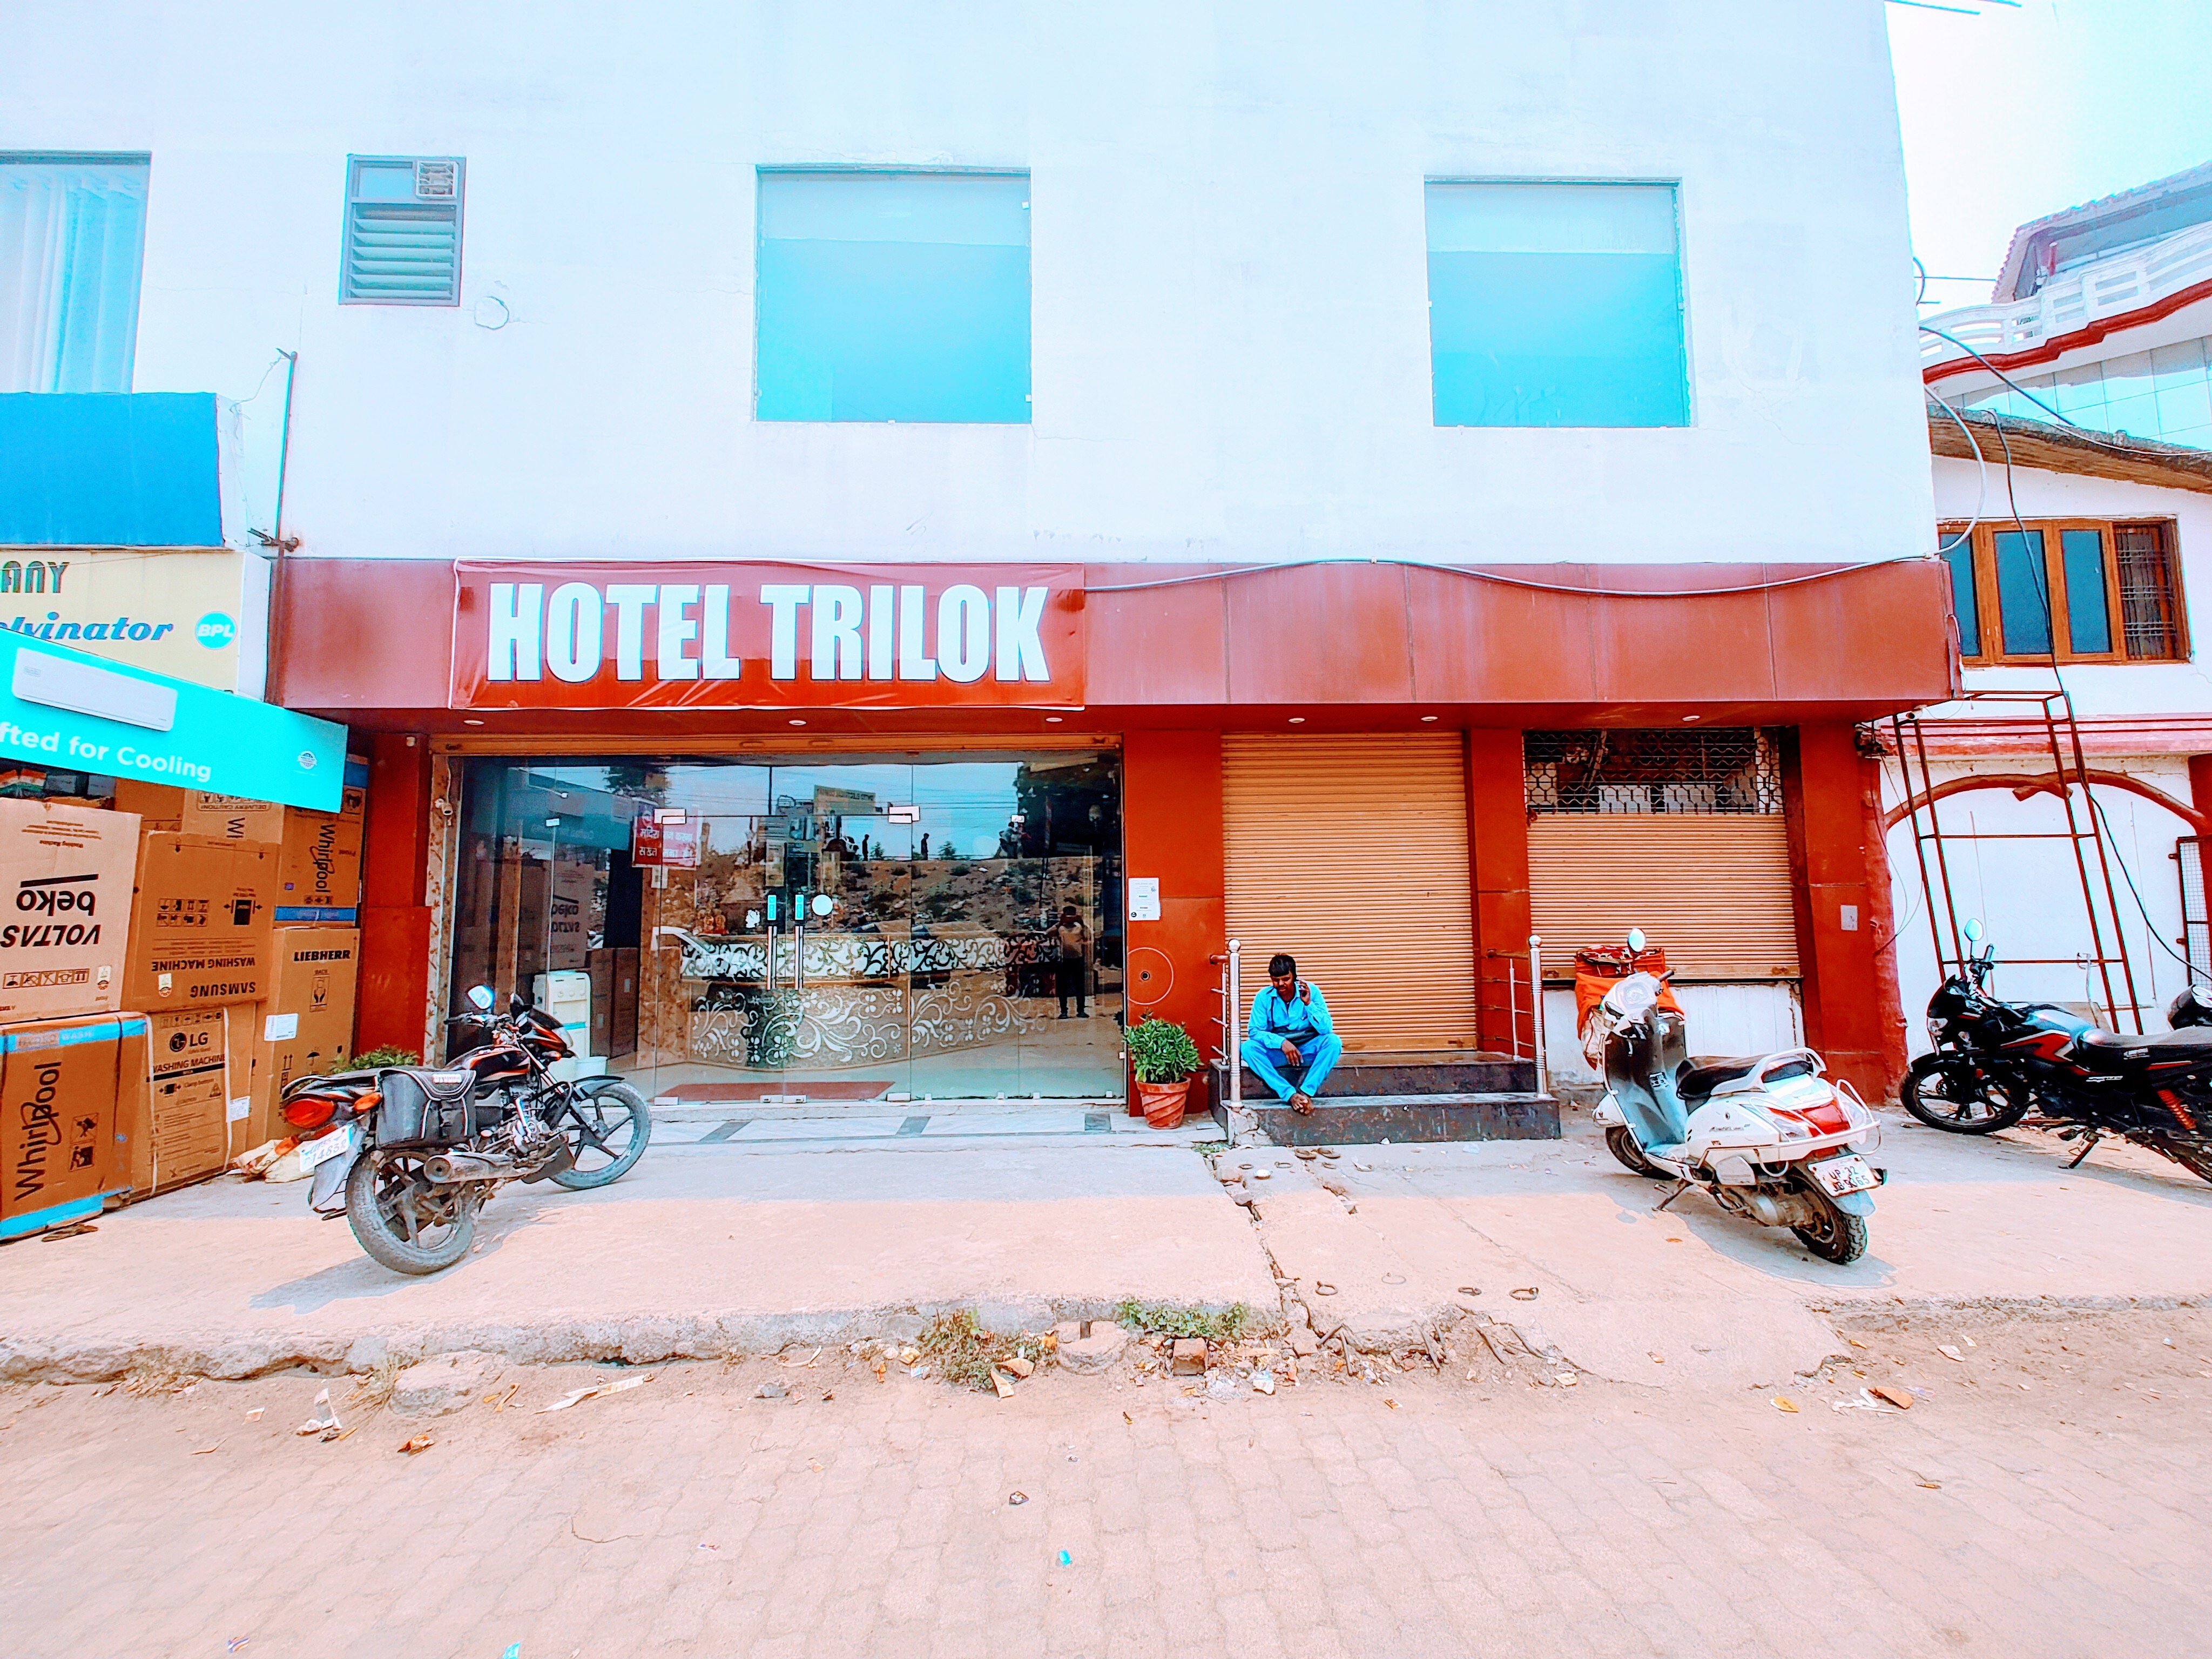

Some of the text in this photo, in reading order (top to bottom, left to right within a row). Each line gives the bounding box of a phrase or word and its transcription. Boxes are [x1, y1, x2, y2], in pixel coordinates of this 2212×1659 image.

[0, 612, 174, 640] lvinator
[198, 624, 233, 637] BPL
[486, 582, 1051, 683] HOTEL TRILOK
[0, 721, 211, 783] fted for Cooling
[311, 824, 336, 893] Whirlpool
[16, 890, 96, 916] beko
[0, 925, 101, 948] VOLTAS
[152, 957, 255, 972] WASHING MACHINE
[294, 950, 350, 962] LIEBHERR
[190, 982, 256, 998] SAMSUNG
[190, 1032, 208, 1047] LG
[14, 1062, 62, 1202] Whirlpool
